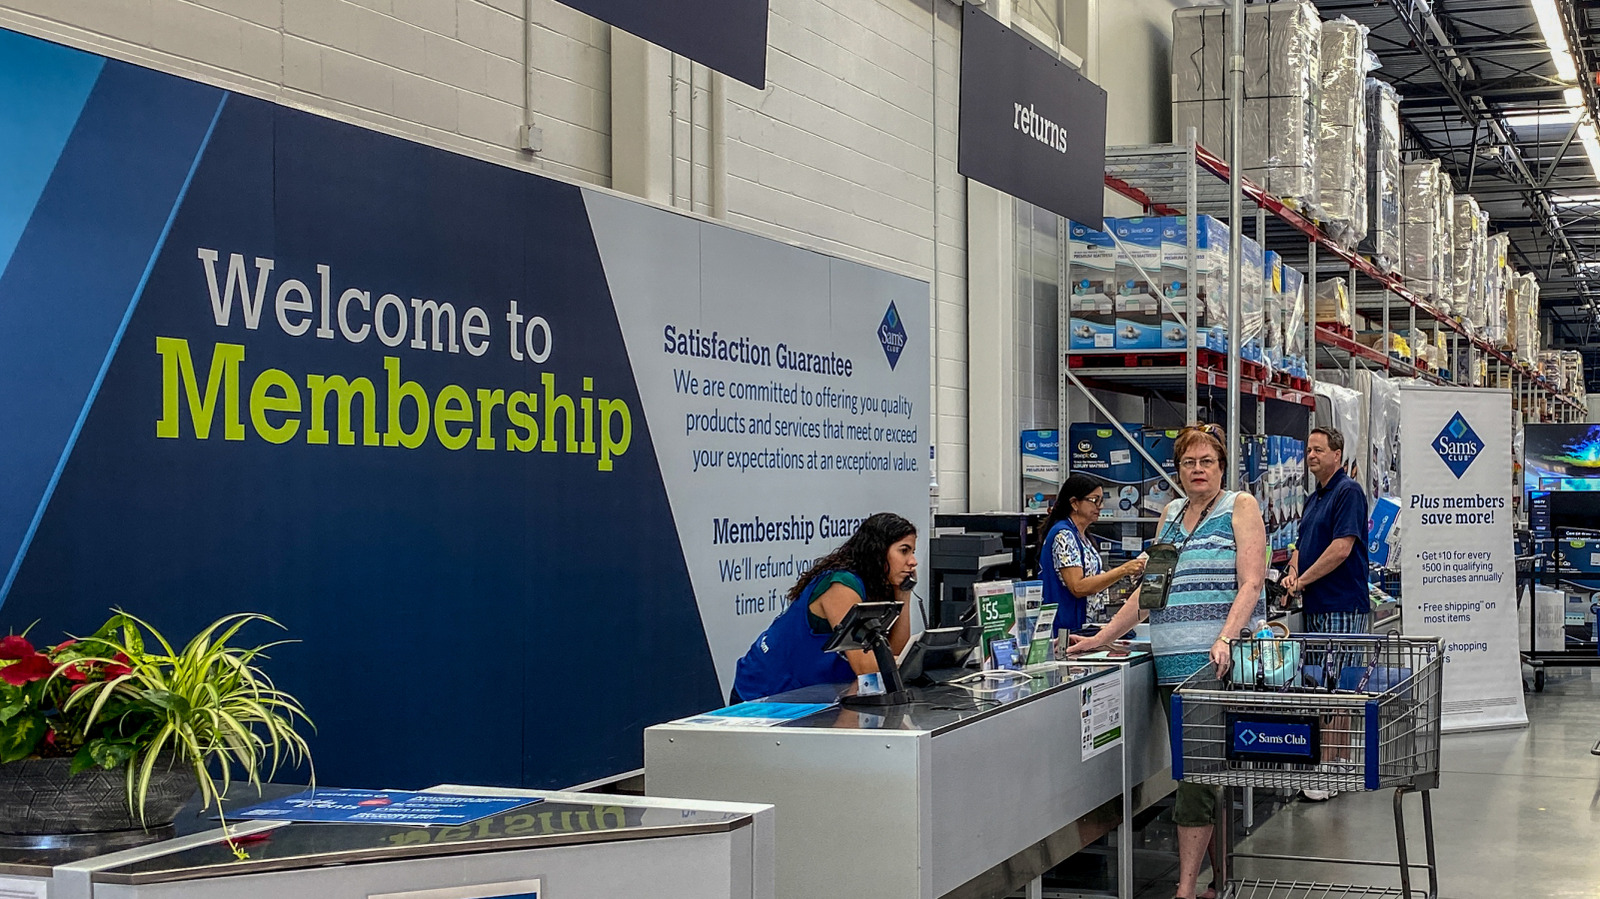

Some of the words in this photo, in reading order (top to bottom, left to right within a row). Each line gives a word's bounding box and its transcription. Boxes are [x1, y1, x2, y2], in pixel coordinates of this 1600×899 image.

[1013, 102, 1067, 153] returns
[197, 247, 491, 357] Welcome
[507, 300, 553, 363] to
[881, 325, 904, 347] Sam's
[664, 324, 771, 367] Satisfaction
[776, 343, 853, 377] Guarantee
[155, 336, 633, 471] Membership
[674, 368, 699, 395] We
[703, 377, 725, 397] are
[729, 380, 797, 405] committed
[801, 386, 813, 406] to
[815, 386, 858, 415] offering
[860, 396, 878, 414] you
[881, 395, 913, 419] quality
[686, 408, 745, 436] products
[749, 413, 771, 435] and
[774, 416, 820, 438] services
[823, 416, 844, 440] that
[846, 420, 872, 442] meet
[874, 427, 884, 442] or
[886, 425, 917, 443] exceed
[1439, 436, 1477, 455] Sam's
[693, 449, 724, 472] your
[727, 448, 804, 473] expectations
[806, 450, 818, 469] at
[820, 454, 833, 470] an
[836, 451, 891, 474] exceptional
[893, 452, 919, 471] value.
[1410, 494, 1440, 509] Plus
[1442, 494, 1505, 509] members
[1421, 512, 1452, 525] save
[1455, 510, 1495, 524] more!
[713, 515, 814, 544] Membership
[819, 512, 872, 539] Guara
[1422, 551, 1437, 561] Get
[1438, 551, 1452, 560] $10
[1453, 551, 1466, 559] for
[1467, 551, 1491, 561] every
[719, 557, 751, 582] We'll
[755, 554, 793, 579] refund
[1422, 562, 1441, 572] $500
[1443, 562, 1451, 571] in
[1452, 561, 1493, 573] qualifying
[1422, 574, 1467, 586] purchases
[735, 592, 764, 615] time
[768, 589, 777, 611] if
[982, 601, 999, 620] $55
[1423, 602, 1442, 612] Free
[1485, 601, 1496, 609] on
[1424, 614, 1446, 623] most
[1447, 613, 1471, 623] items
[1448, 641, 1487, 652] shopping
[1258, 732, 1283, 744] Sam's
[1284, 733, 1307, 745] Club
